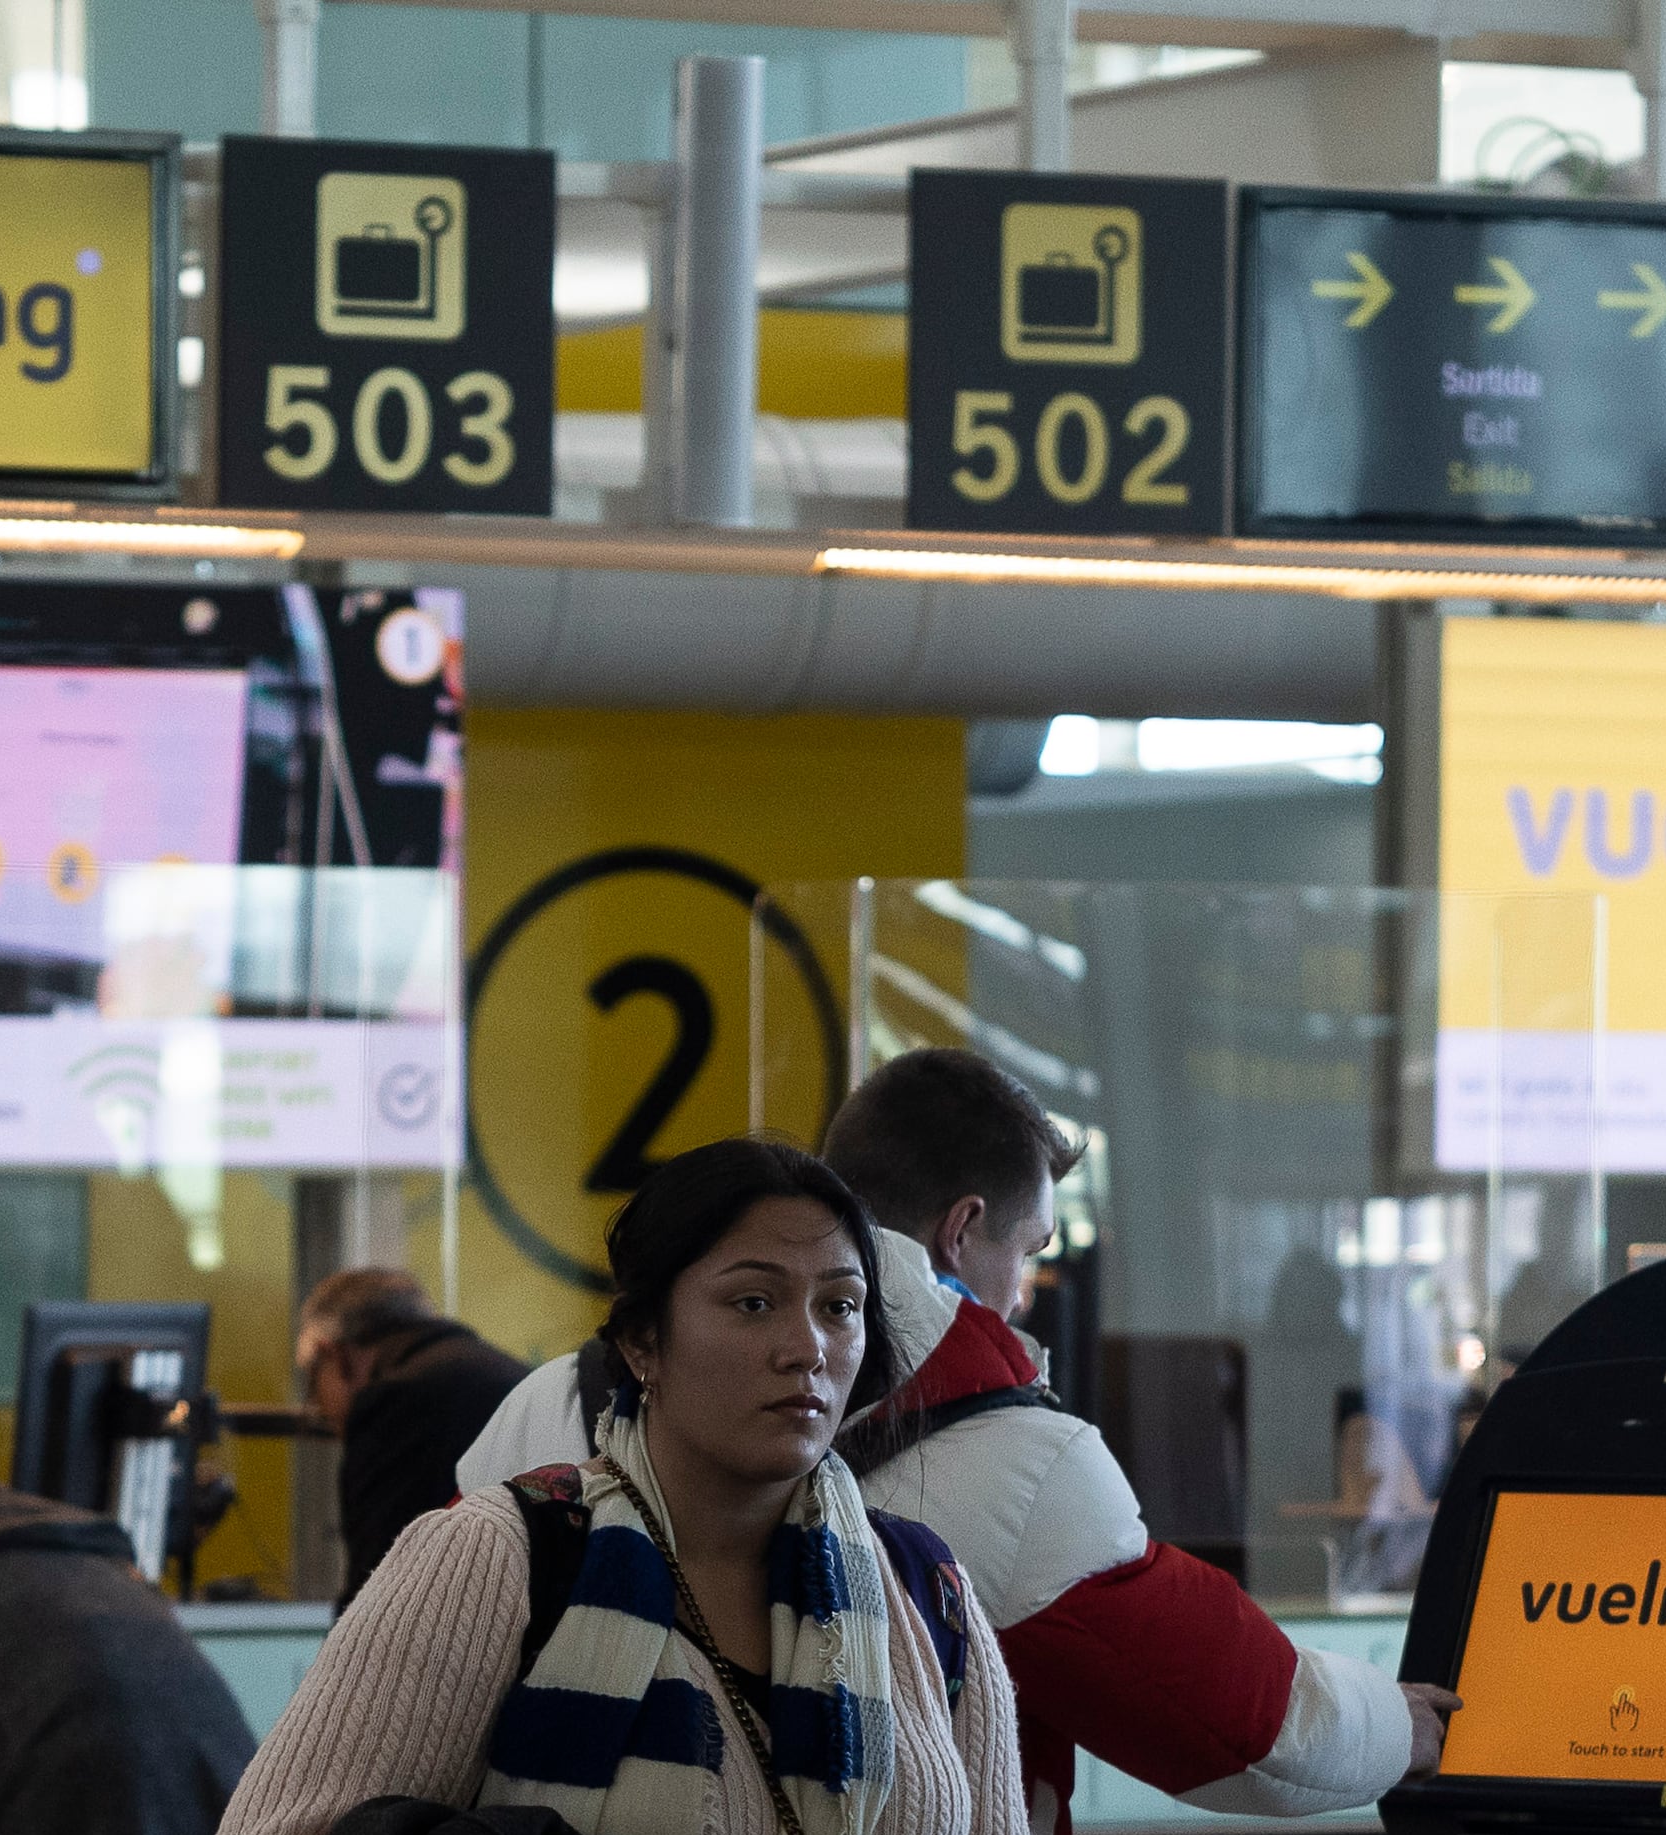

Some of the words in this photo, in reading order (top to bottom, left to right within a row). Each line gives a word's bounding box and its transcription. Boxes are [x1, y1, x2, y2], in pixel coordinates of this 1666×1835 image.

[262, 365, 517, 487] 503
[951, 390, 1190, 504] 502
[1464, 412, 1518, 446] Exit
[582, 952, 718, 1194] 2
[1567, 1741, 1610, 1758] Touch
[1612, 1744, 1627, 1758] to
[1631, 1743, 1665, 1759] start
